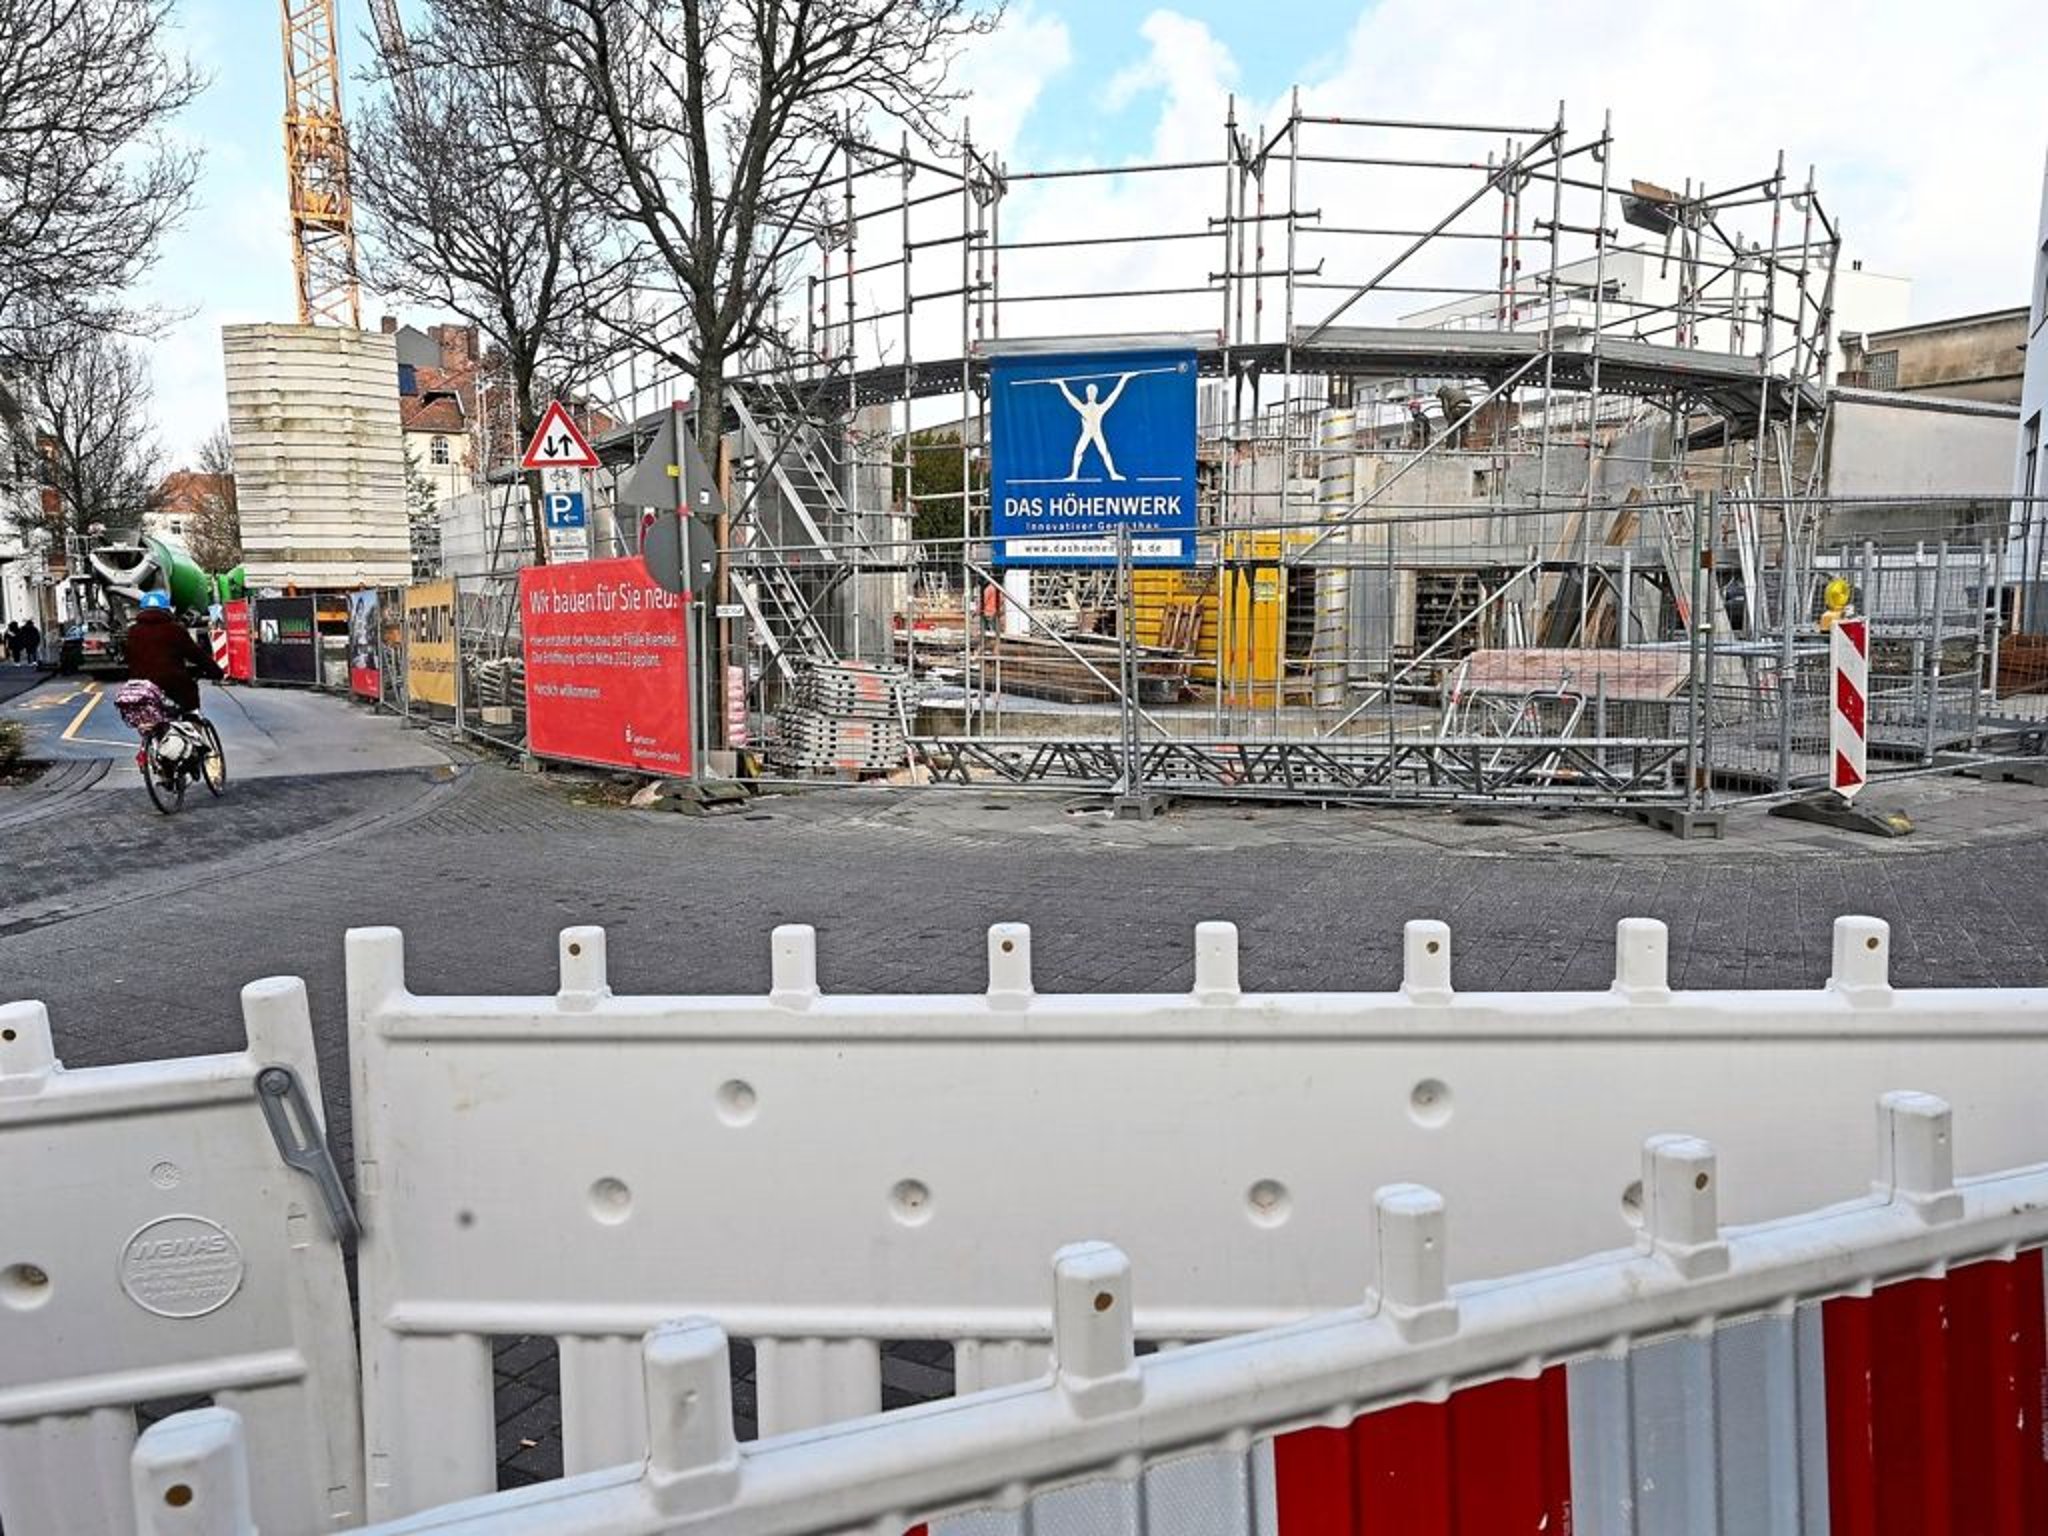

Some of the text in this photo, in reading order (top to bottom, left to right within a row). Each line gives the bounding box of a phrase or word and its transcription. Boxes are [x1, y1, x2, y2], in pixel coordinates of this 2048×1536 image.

[551, 494, 573, 523] P
[1005, 493, 1182, 517] DAS HÖHENWERK
[1025, 521, 1160, 532] Innovativer Gertbau
[530, 590, 550, 614] Wir
[553, 587, 593, 614] bauen
[596, 583, 617, 612] für
[619, 582, 641, 611] Sie
